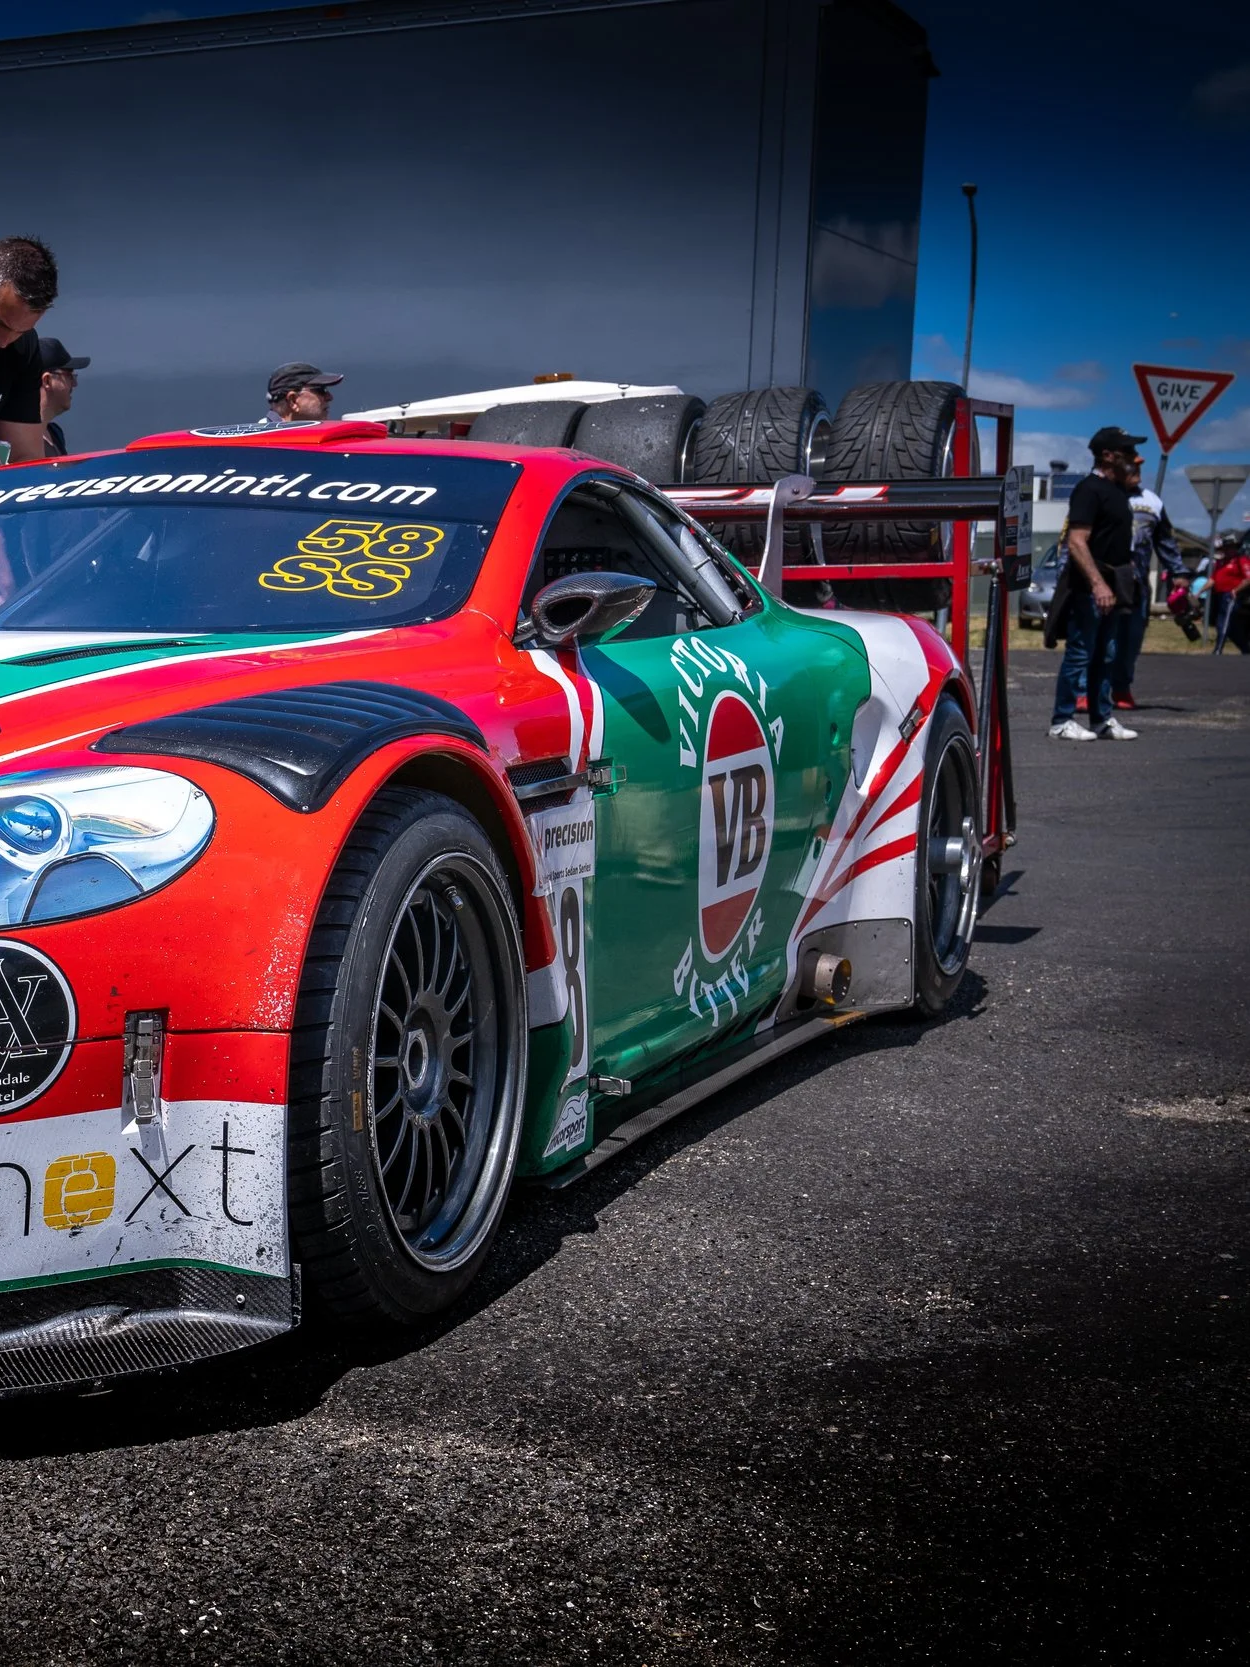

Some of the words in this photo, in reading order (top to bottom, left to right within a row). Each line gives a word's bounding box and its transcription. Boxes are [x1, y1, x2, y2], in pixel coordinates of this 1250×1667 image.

[1157, 382, 1202, 399] GIVE
[1160, 399, 1192, 413] WAY
[298, 519, 445, 562] 58
[258, 554, 411, 600] SS
[670, 636, 784, 769] VICTORIA
[545, 820, 593, 857] precision
[708, 762, 766, 889] VB
[565, 866, 578, 877] Sedan
[673, 907, 765, 1028] BITTER
